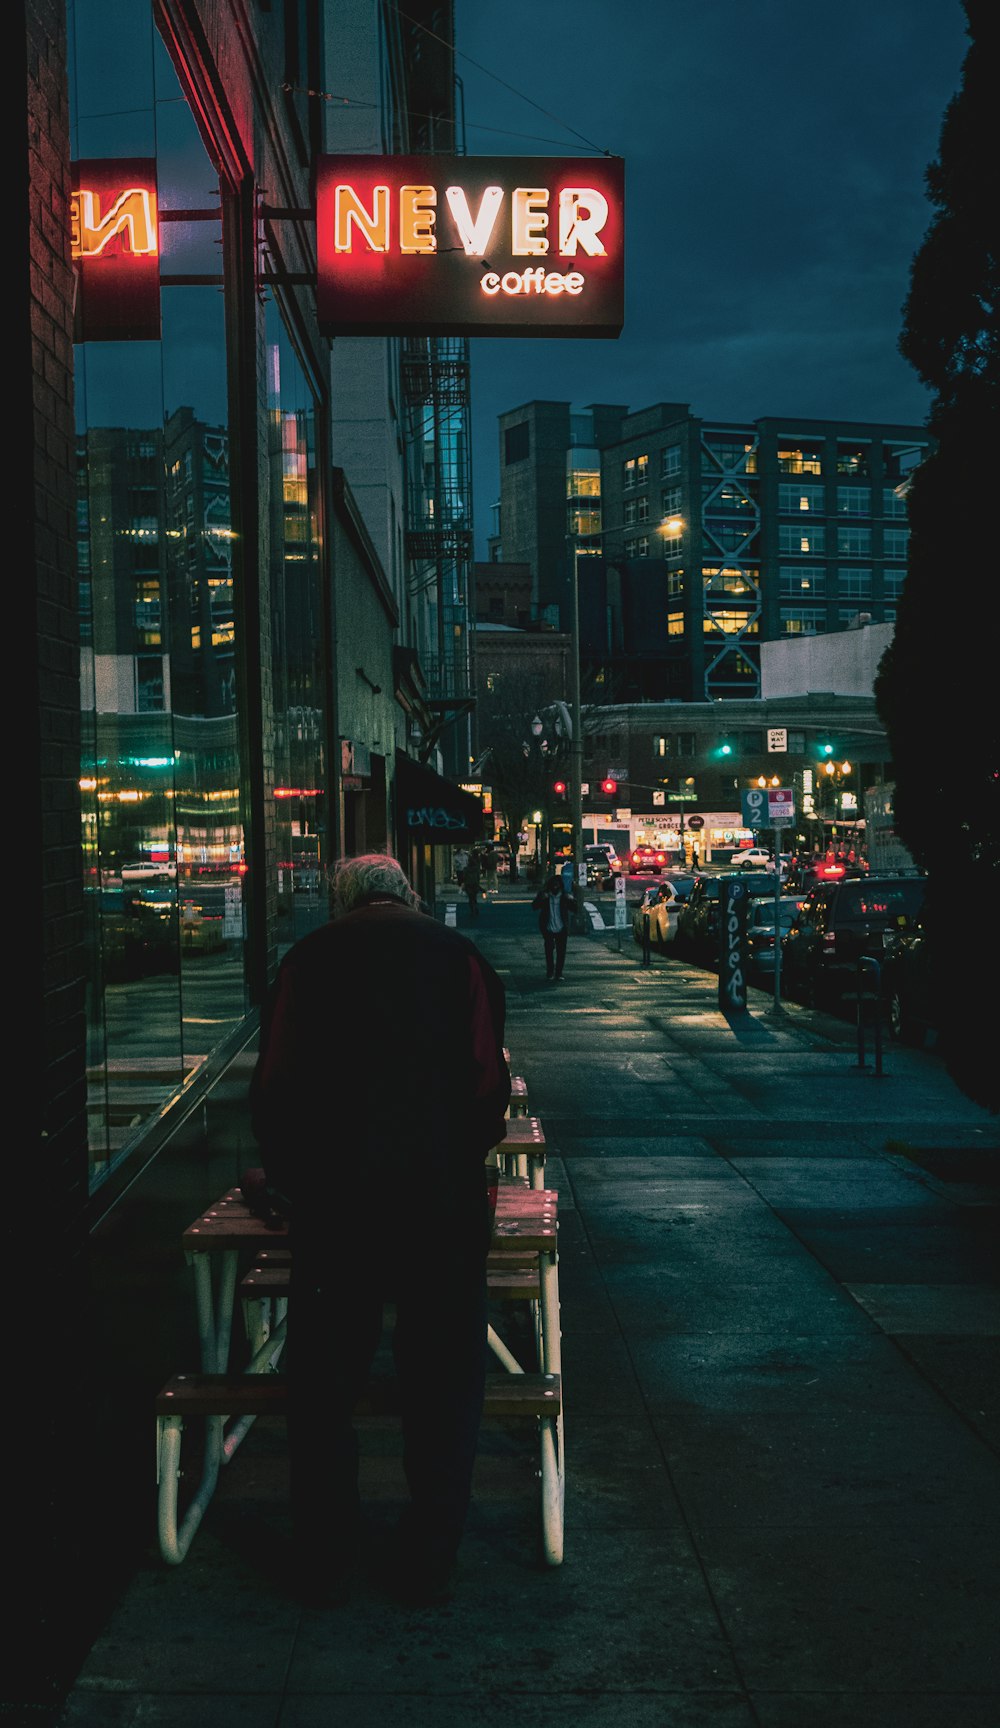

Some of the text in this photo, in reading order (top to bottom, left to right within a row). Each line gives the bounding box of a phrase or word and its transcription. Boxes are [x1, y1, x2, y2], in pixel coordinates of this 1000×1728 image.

[332, 184, 609, 258] NEVER
[480, 266, 585, 297] coffee
[751, 808, 762, 823] 2
